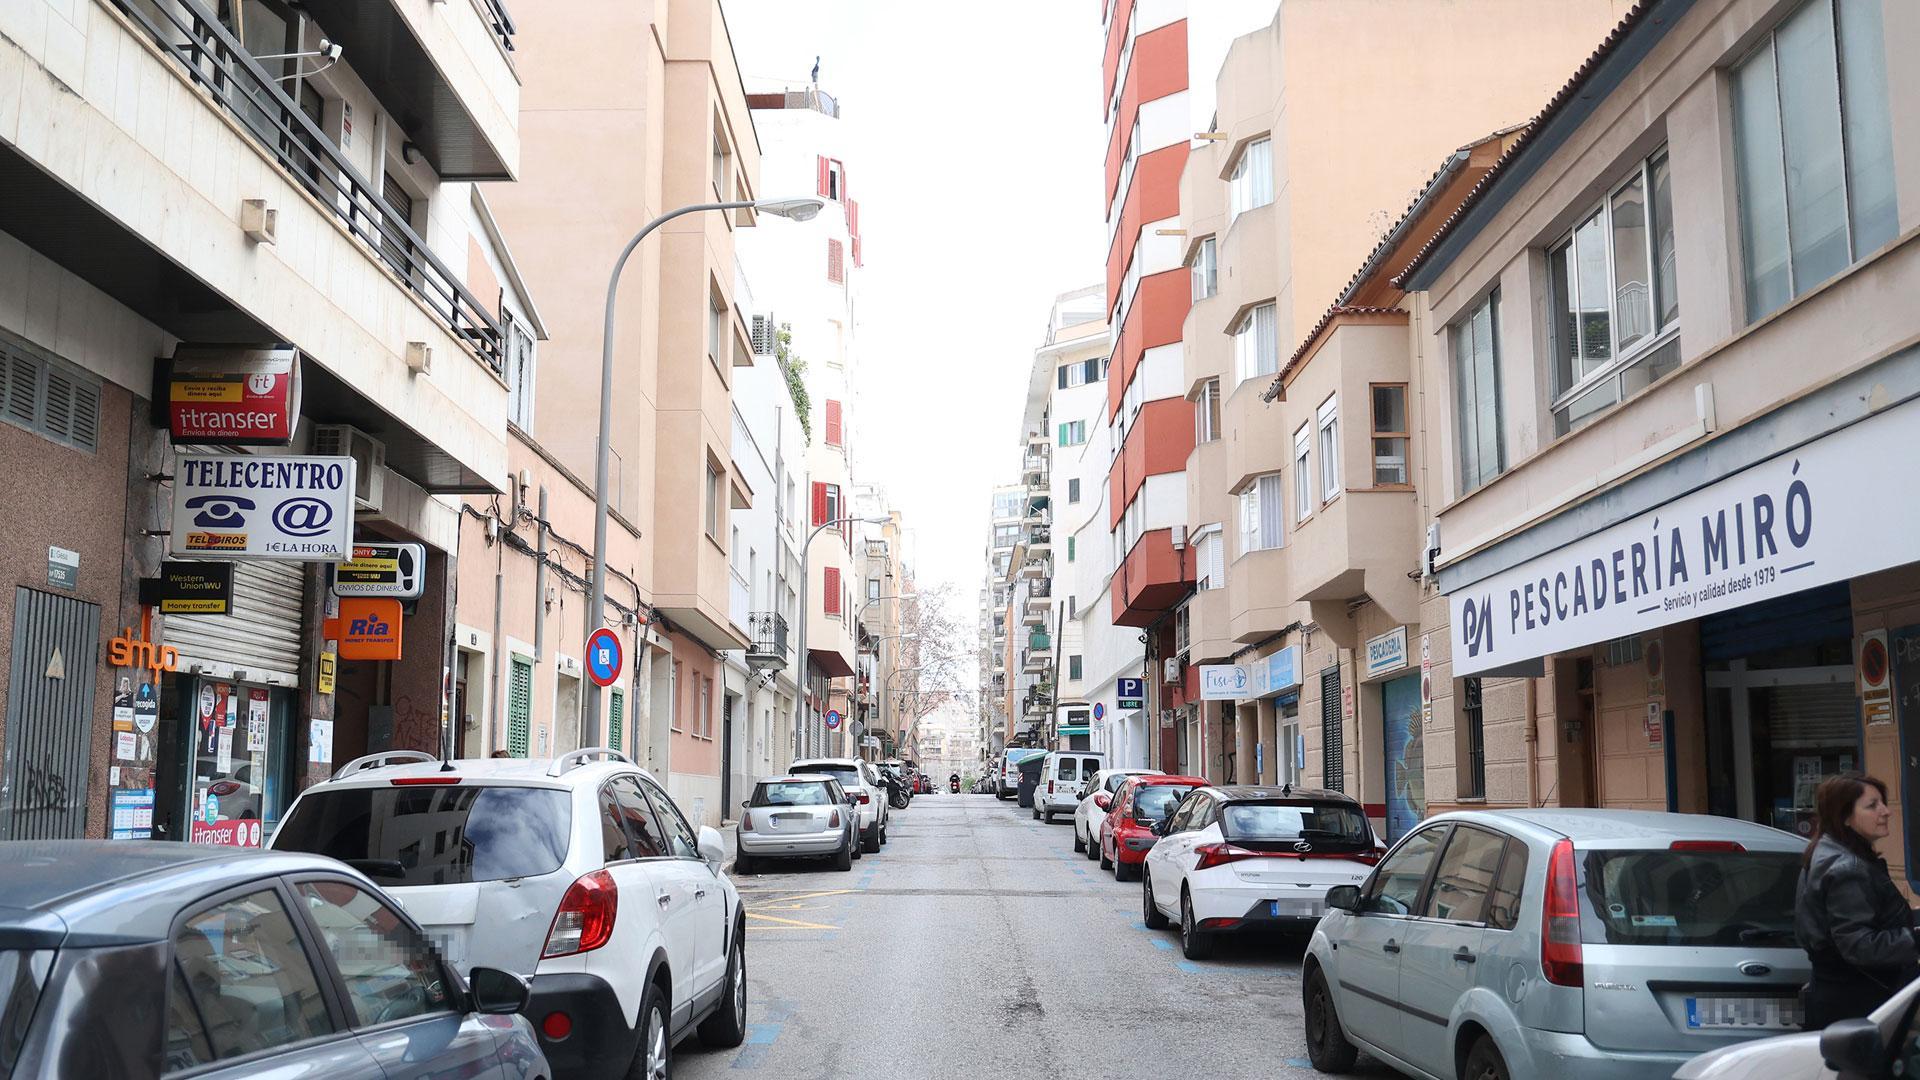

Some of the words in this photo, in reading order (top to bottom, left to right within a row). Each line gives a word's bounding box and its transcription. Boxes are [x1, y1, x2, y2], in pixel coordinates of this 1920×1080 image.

[216, 429, 239, 437] dinero
[183, 459, 343, 490] TELECENTRO
[282, 543, 298, 552] LA
[302, 543, 337, 553] HORA
[1510, 516, 1688, 635] PESCADERÍA
[1702, 458, 1812, 576] MIRÓ
[170, 574, 205, 582] Western
[180, 582, 204, 590] Union
[1664, 591, 1691, 611] Servicio
[1692, 593, 1697, 608] y
[1699, 580, 1726, 602] calidad
[1727, 574, 1752, 594] desde
[1753, 566, 1776, 586] 1979
[349, 613, 389, 635] Ria
[1124, 680, 1137, 696] P
